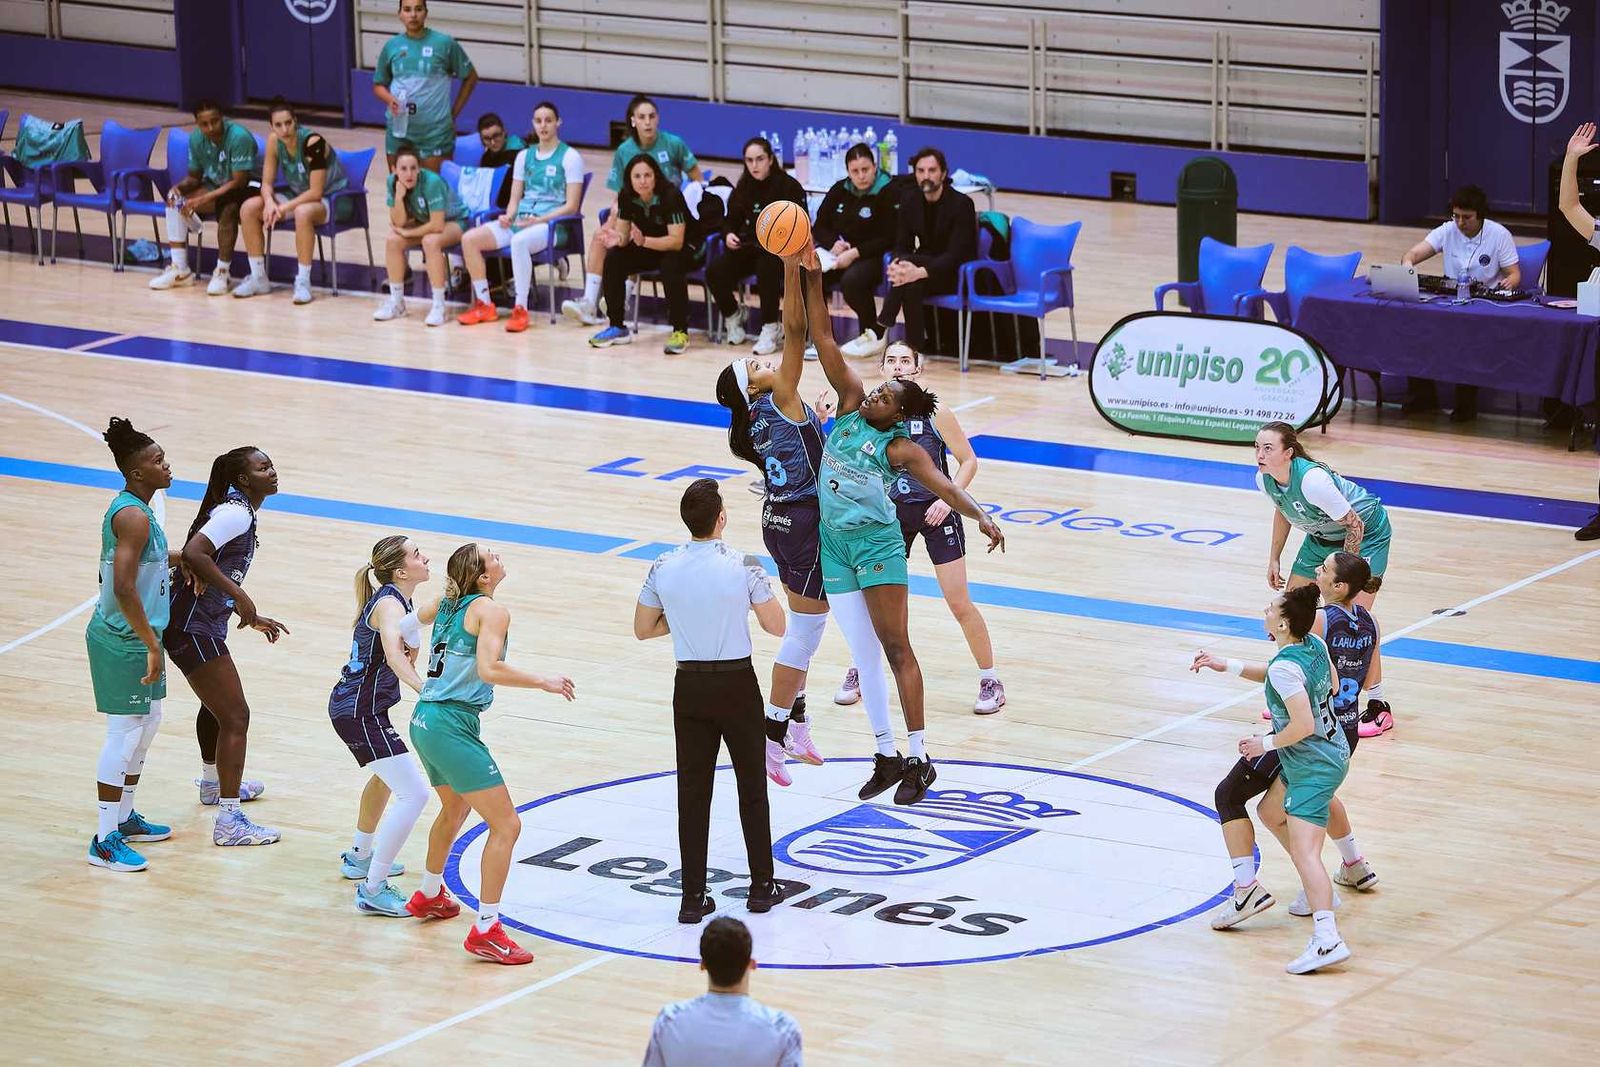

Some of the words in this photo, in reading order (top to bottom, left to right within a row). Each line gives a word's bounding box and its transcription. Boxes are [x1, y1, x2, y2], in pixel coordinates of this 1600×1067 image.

[1136, 343, 1244, 388] unipiso
[1255, 347, 1310, 385] 20
[1107, 397, 1169, 409] www.unipiso.es
[1174, 402, 1238, 414] info@unipiso.es
[1244, 408, 1254, 417] 91
[1256, 410, 1271, 419] 498
[1273, 411, 1284, 420] 72
[1186, 417, 1204, 425] Plaza
[586, 456, 749, 481] LF
[897, 477, 911, 495] 6
[517, 836, 1028, 937] Leganés
